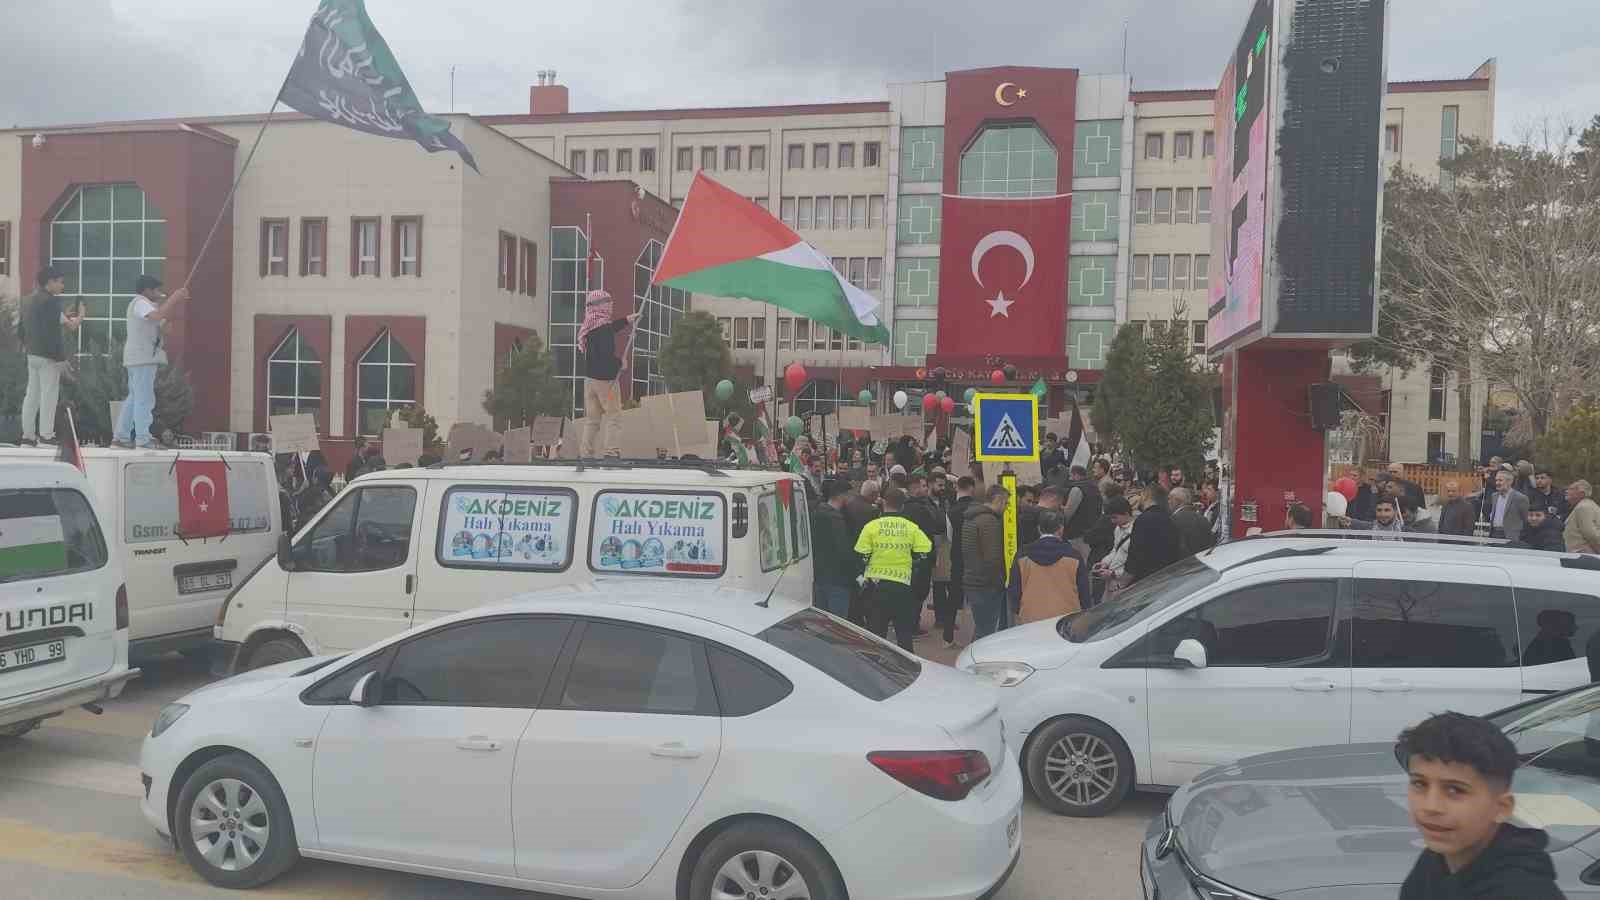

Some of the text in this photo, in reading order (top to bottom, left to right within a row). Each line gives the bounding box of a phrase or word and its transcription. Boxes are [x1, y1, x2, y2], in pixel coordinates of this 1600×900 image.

[466, 496, 562, 516] AKDENİZ
[615, 497, 714, 520] AKDENİZ
[133, 524, 168, 538] Gsm:
[464, 517, 552, 531] Halı Yıkama
[612, 519, 705, 537] Halı Yıkama
[0, 602, 93, 631] UNDAI
[16, 648, 35, 664] YHD
[48, 643, 62, 657] 99
